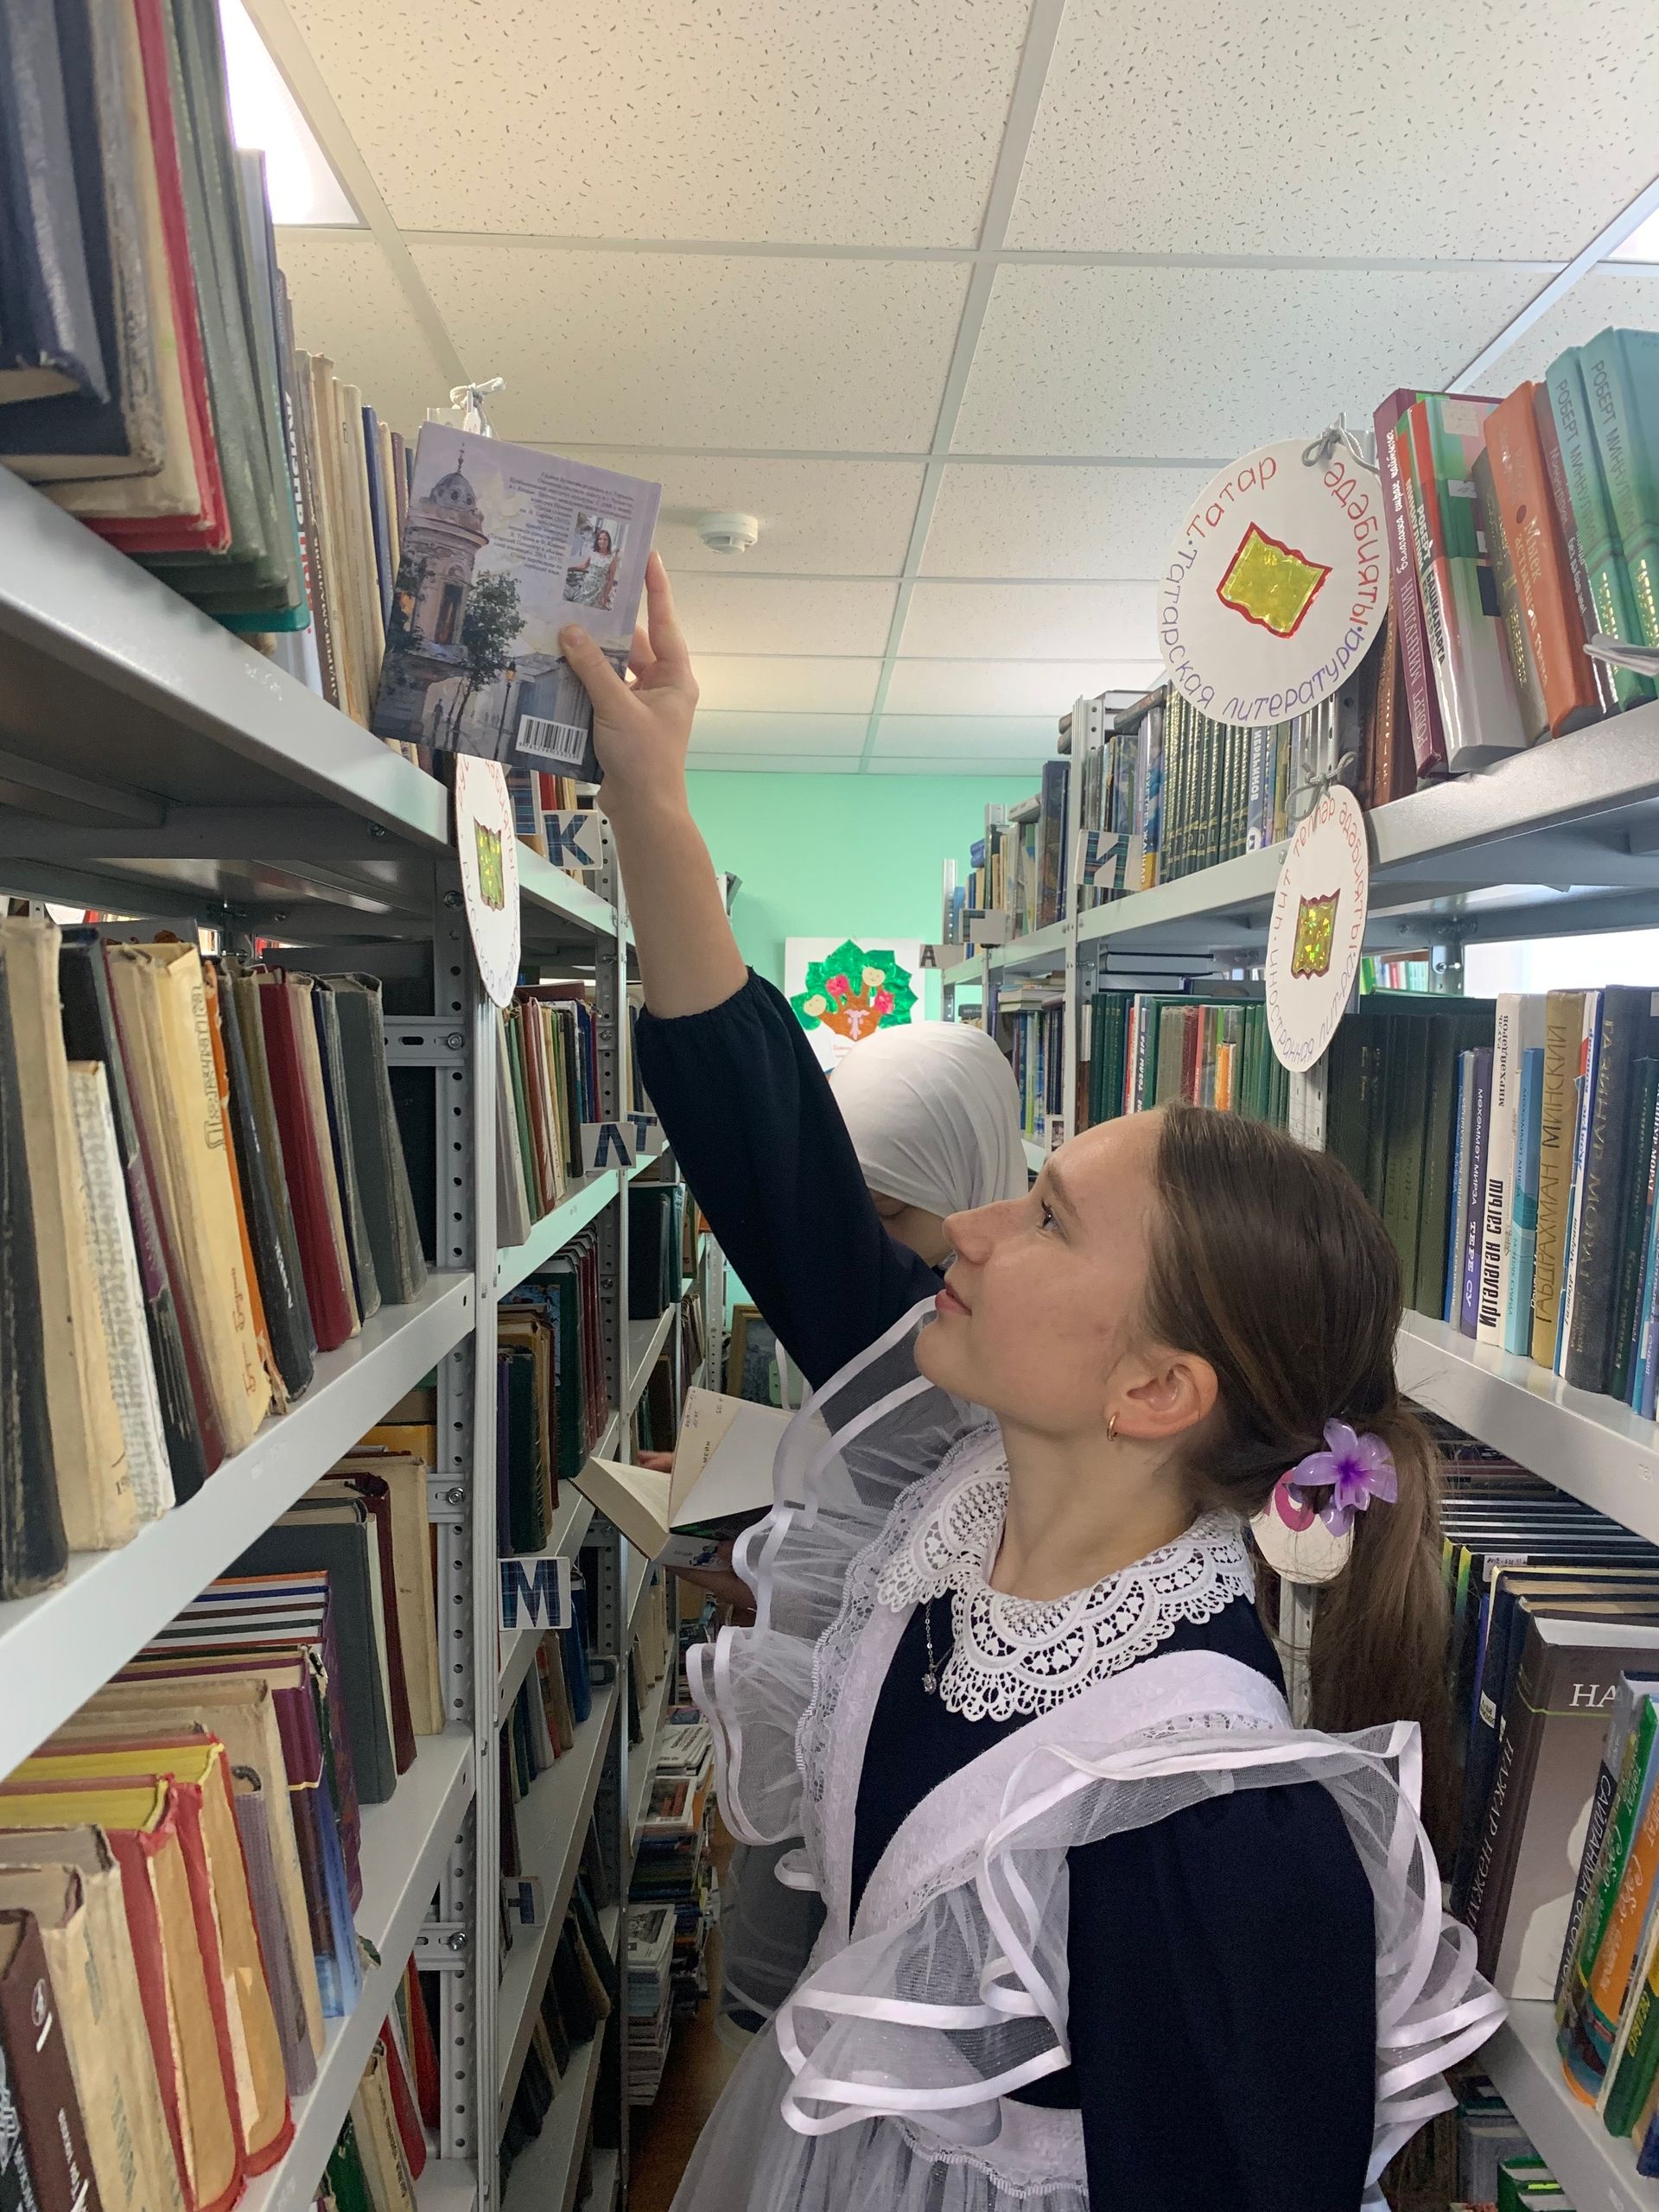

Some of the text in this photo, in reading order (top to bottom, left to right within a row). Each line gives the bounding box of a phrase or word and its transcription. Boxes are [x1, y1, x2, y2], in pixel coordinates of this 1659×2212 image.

[1556, 379, 1578, 443] РОБЕРТ
[1592, 360, 1614, 429] РОБЕРТ
[1186, 457, 1276, 537] Татар
[1417, 505, 1432, 559] РОБЕРТ
[1223, 627, 1363, 721] литература
[1412, 691, 1427, 747] РОБЕРТ
[1250, 730, 1262, 802] ИБРАҺИМОВ
[544, 814, 595, 867] К
[1084, 831, 1130, 887] И
[920, 944, 937, 968] А
[627, 1115, 657, 1151] Т
[1471, 1164, 1479, 1205] МИРЗА
[1535, 1026, 1565, 1322] ГАБДРАХМАН МИНСКИЙ
[1465, 1222, 1477, 1306] ТЕРЕ СУ
[501, 1559, 560, 1628] М
